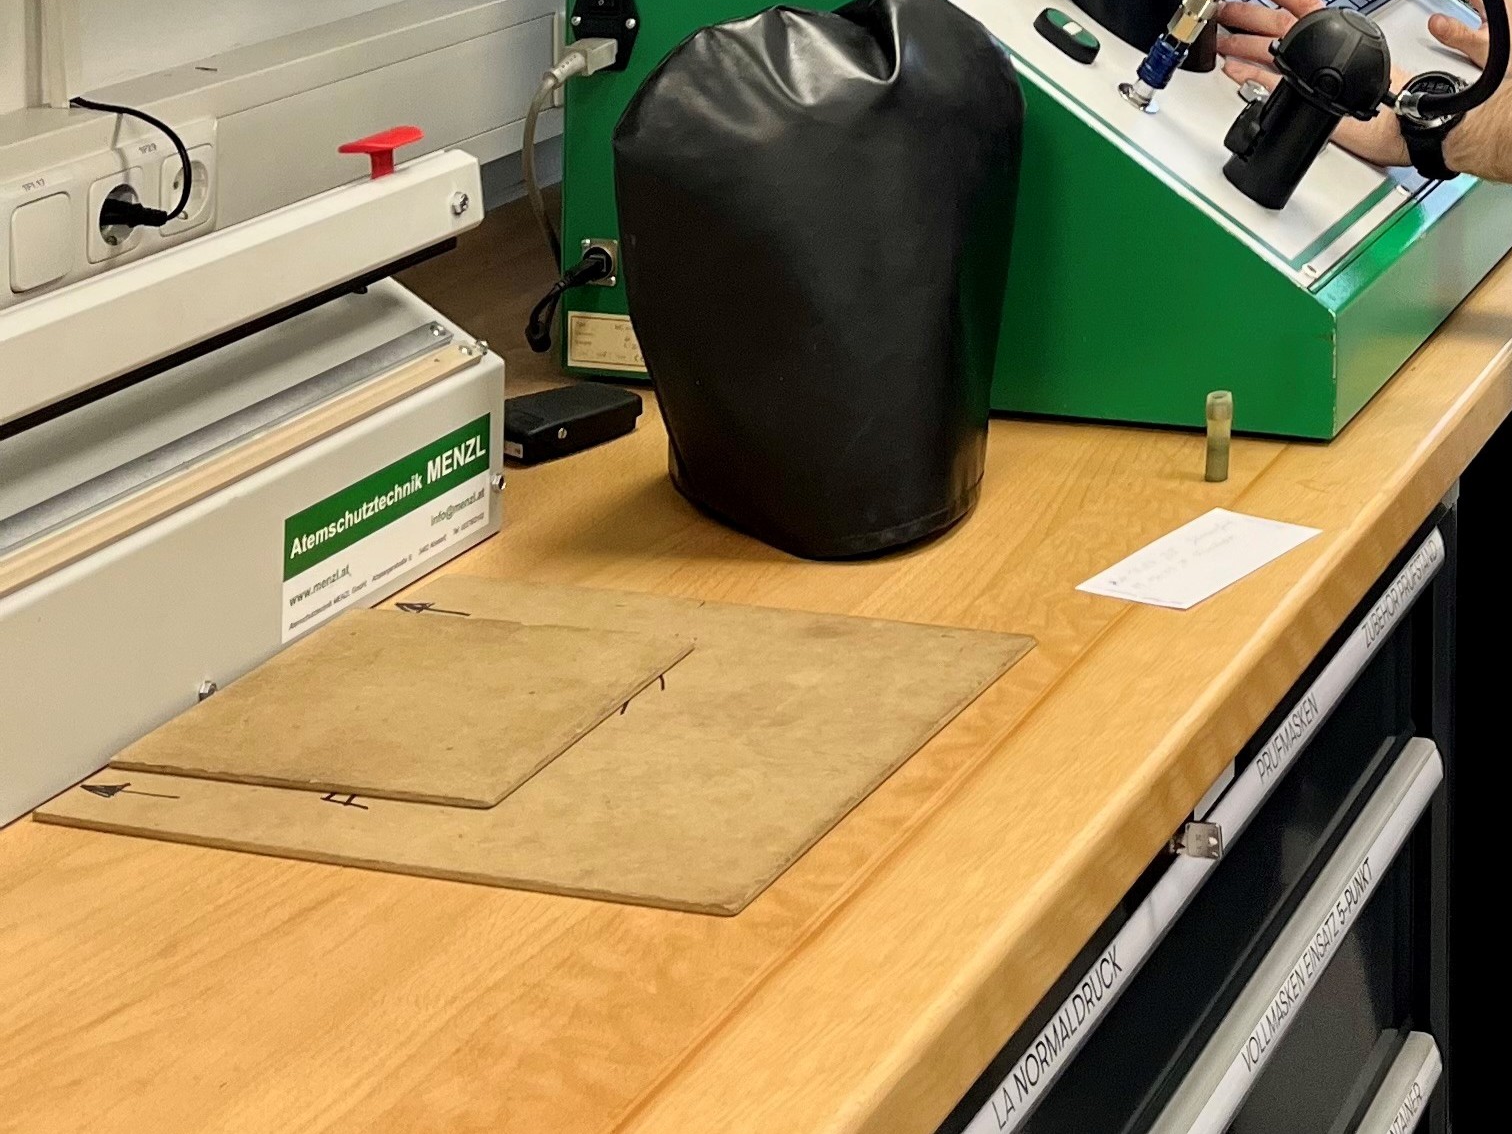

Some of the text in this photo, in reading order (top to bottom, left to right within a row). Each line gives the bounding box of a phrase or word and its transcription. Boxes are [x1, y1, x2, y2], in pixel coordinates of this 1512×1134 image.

[290, 434, 487, 559] Atemschutztechnik MENZL
[431, 488, 485, 526] info@menzl.at
[991, 944, 1123, 1131] LA NORMALDRUCK
[1240, 856, 1374, 1073] VOLLMASKEN EINSATZ 5-PUNKT
